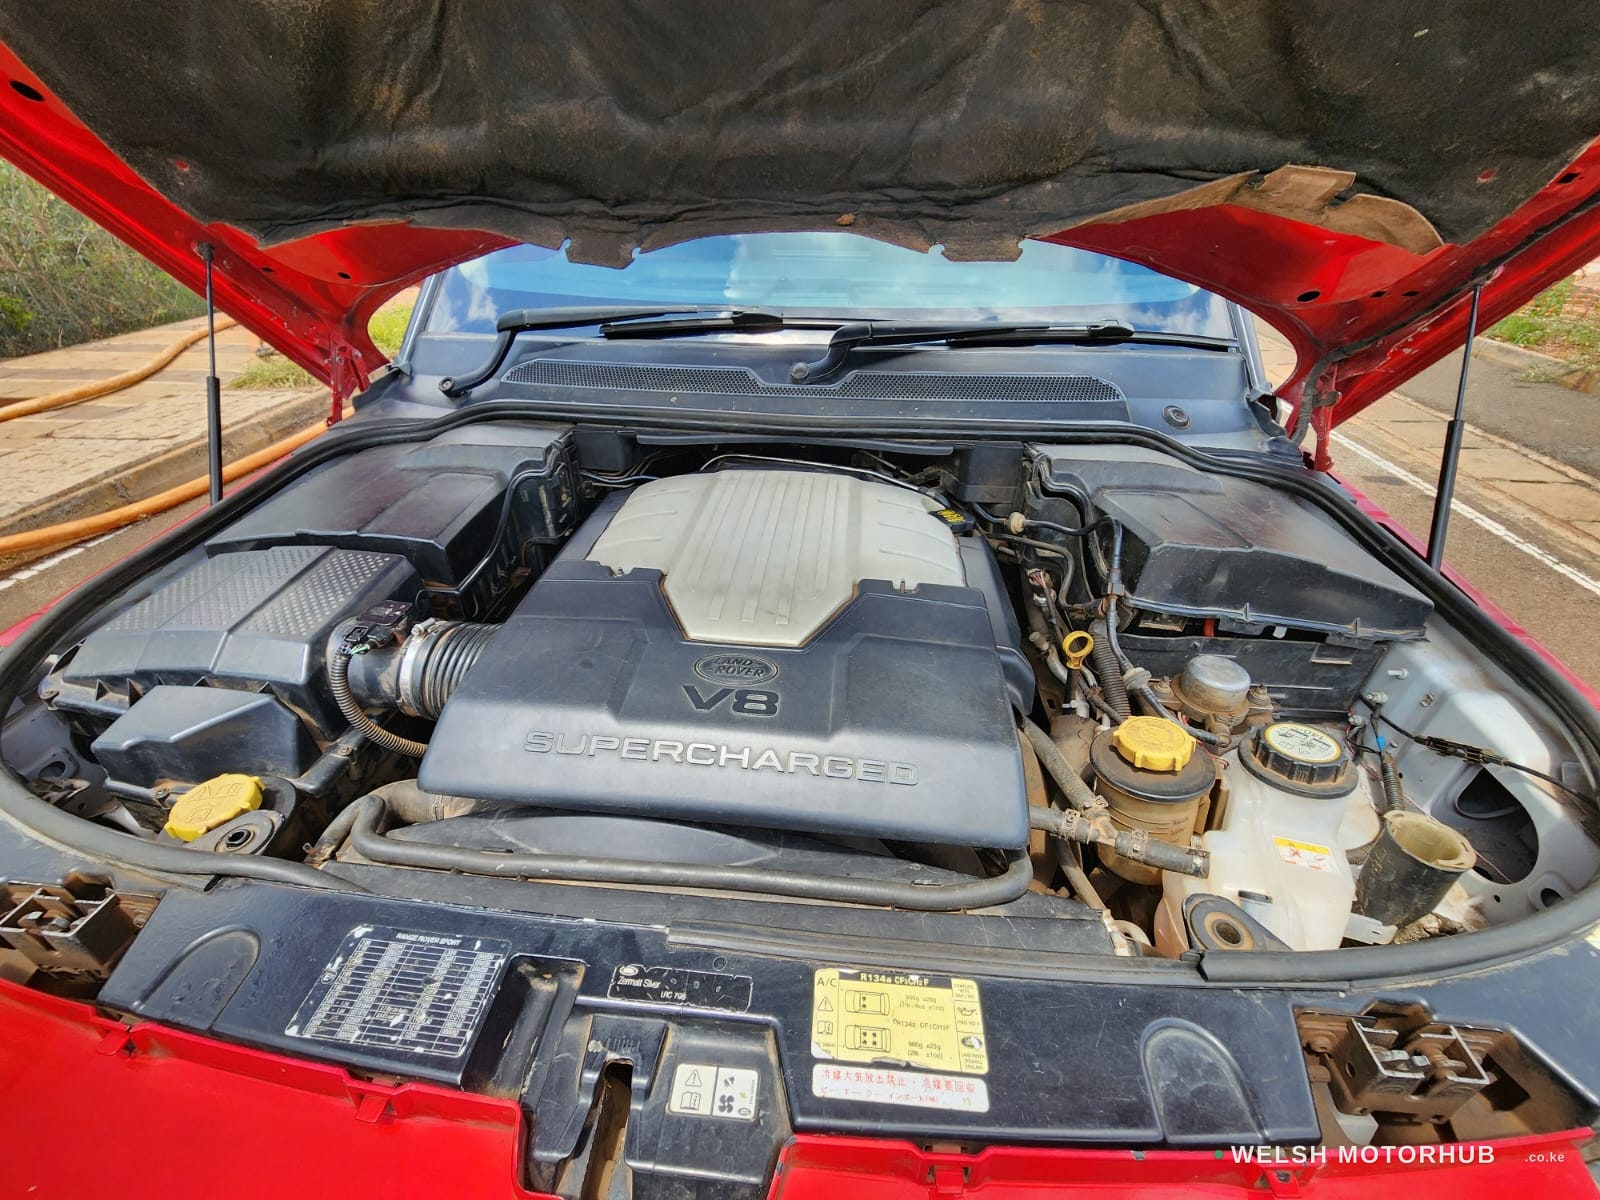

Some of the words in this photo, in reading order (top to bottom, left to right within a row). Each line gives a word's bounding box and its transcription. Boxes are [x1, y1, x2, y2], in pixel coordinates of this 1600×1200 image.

[714, 657, 753, 666] LAND
[715, 665, 765, 678] ROVER
[682, 685, 779, 716] V8
[524, 730, 920, 786] SUPERCHARGED
[396, 932, 419, 941] RANGE
[439, 938, 462, 946] SPORT
[816, 976, 837, 988] A/C
[860, 972, 892, 984] R134a
